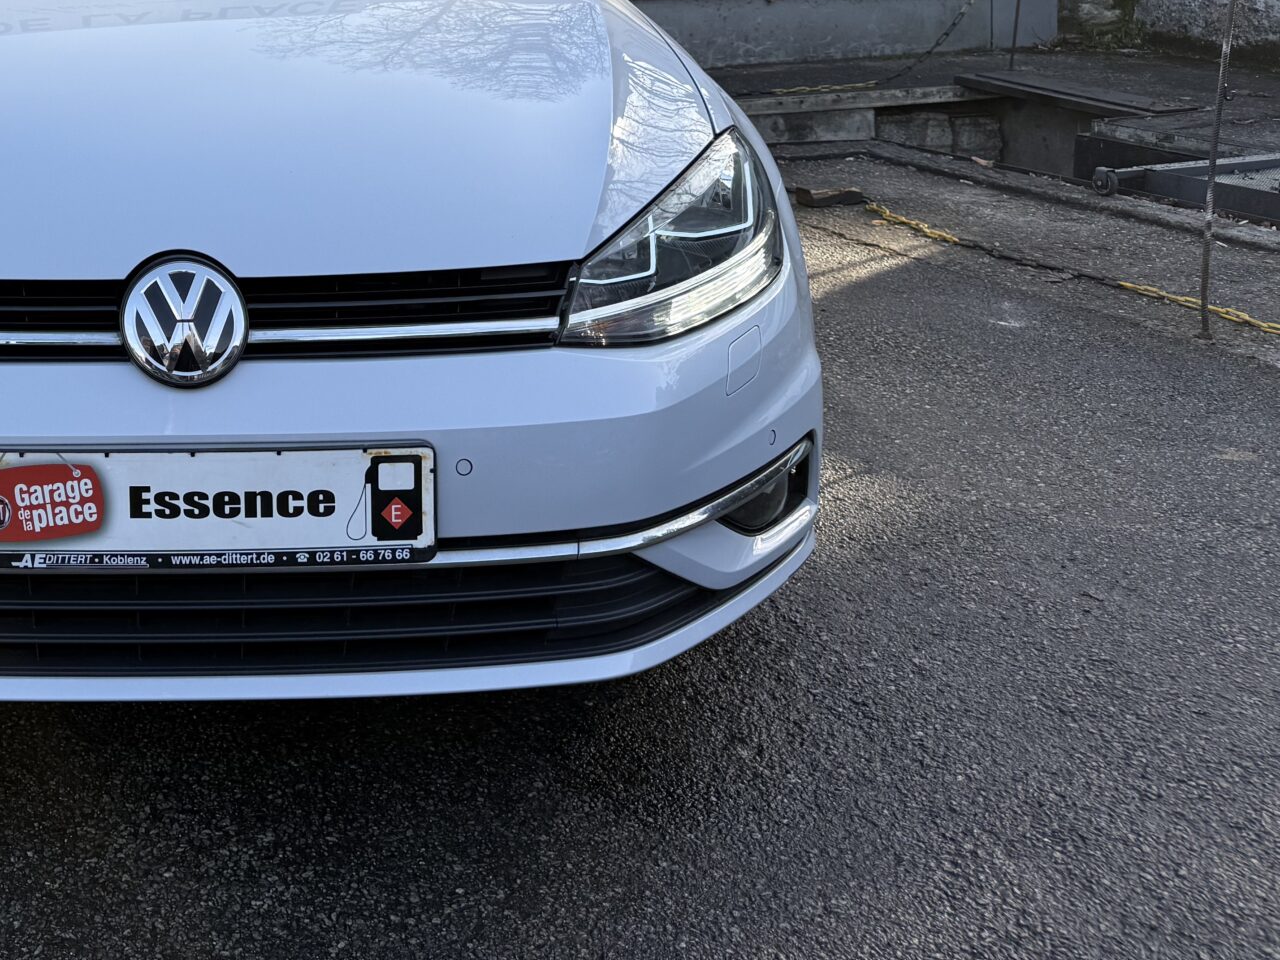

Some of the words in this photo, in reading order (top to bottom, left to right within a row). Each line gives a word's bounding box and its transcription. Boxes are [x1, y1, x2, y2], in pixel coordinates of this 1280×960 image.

[14, 478, 94, 507] Garage
[128, 484, 337, 520] Essence
[18, 507, 31, 521] de
[32, 502, 98, 533] place
[391, 504, 403, 523] E
[23, 520, 33, 532] la
[102, 553, 147, 565] Koblenz
[170, 552, 275, 565] www.ae-dittert.de
[315, 551, 331, 563] 02
[333, 551, 348, 562] 61
[359, 550, 375, 561] 66
[377, 549, 393, 561] 76
[395, 548, 411, 560] 66
